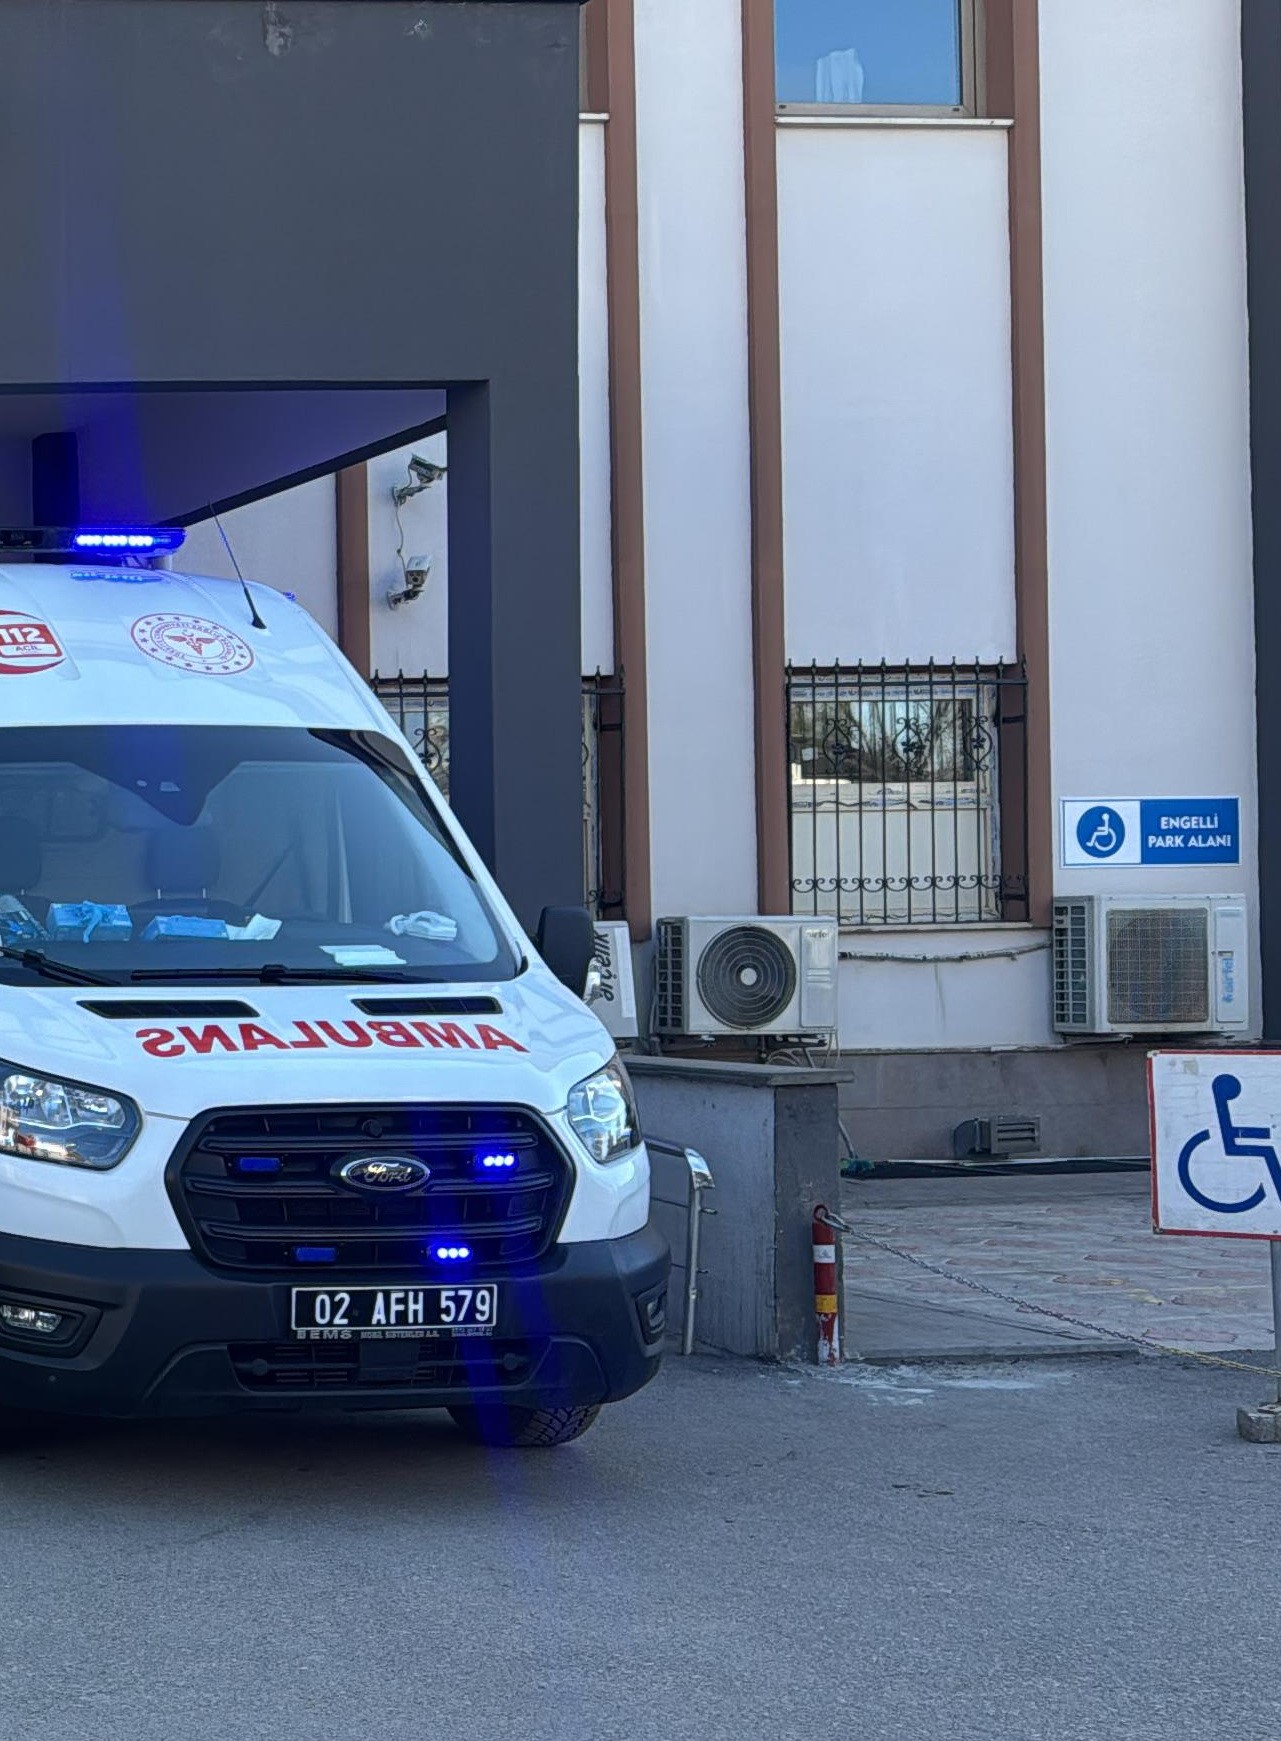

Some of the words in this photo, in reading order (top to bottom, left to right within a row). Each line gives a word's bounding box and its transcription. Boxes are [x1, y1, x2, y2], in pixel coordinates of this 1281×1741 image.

[1160, 813, 1219, 830] ENGELLİ
[1148, 835, 1185, 848] PARK
[1187, 835, 1232, 848] ALANI
[364, 1162, 412, 1183] Ford
[315, 1293, 351, 1325] 02
[371, 1291, 424, 1325] AFH
[440, 1289, 491, 1323] 579
